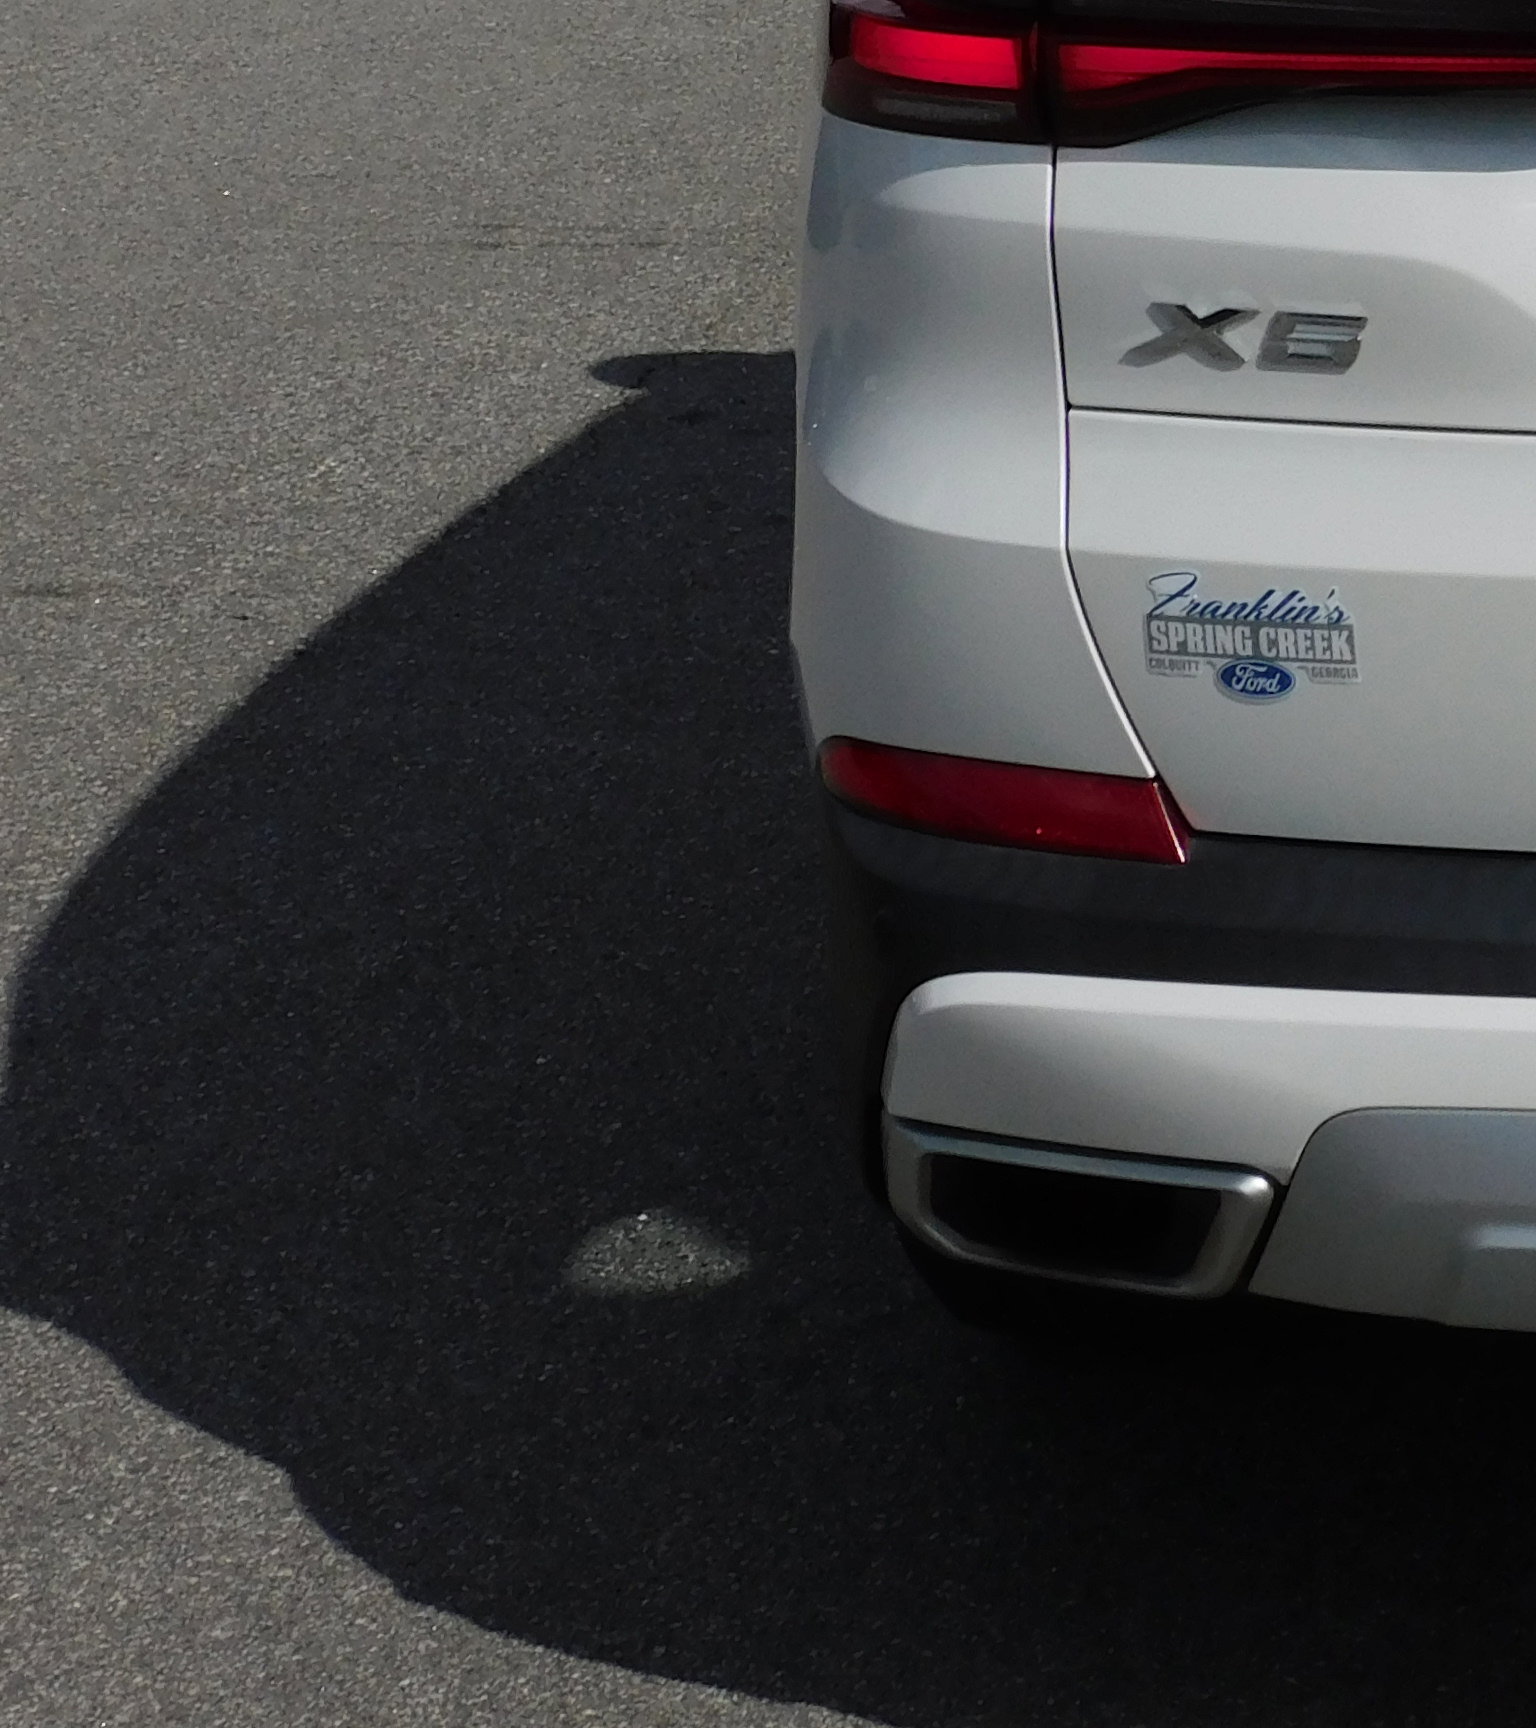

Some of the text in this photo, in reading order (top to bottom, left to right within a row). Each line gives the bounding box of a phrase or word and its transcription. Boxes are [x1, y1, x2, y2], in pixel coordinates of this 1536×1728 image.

[1148, 572, 1350, 624] Franklin's
[1150, 619, 1352, 661] SPRING CREEK
[1230, 665, 1281, 693] Ford
